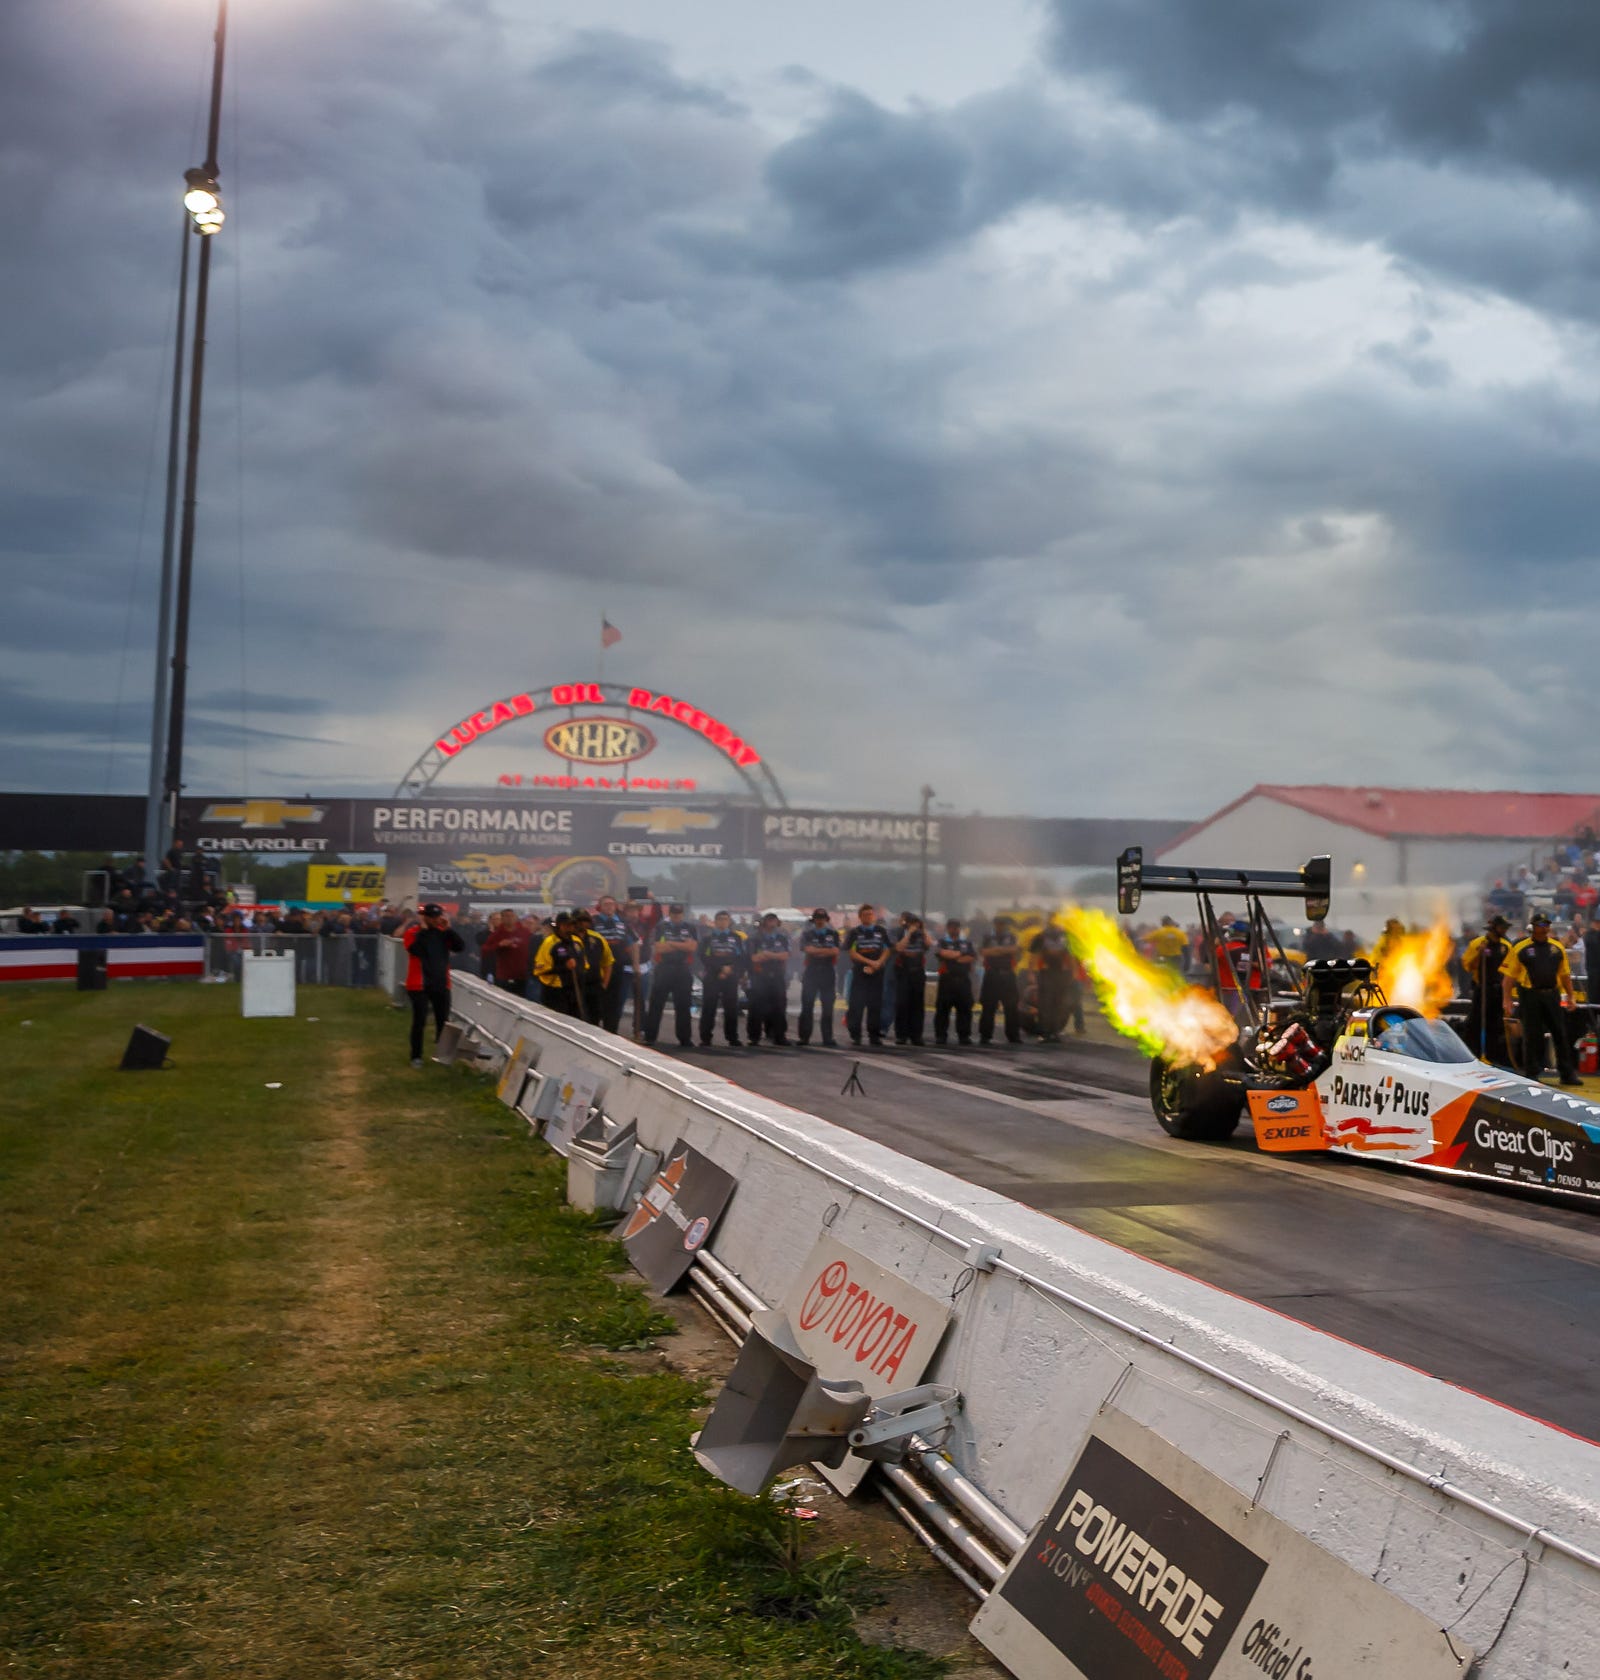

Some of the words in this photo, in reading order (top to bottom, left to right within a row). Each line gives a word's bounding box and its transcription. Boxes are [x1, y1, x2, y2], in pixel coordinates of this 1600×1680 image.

[435, 693, 535, 757] LUCAS
[551, 682, 605, 705] OIL
[628, 687, 762, 767] RACEWAY
[557, 727, 642, 759] NHRA
[533, 775, 696, 791] INDIANAPOLIS
[373, 807, 573, 831] PERFORMANCE
[763, 815, 942, 842] PERFORMANCE
[197, 837, 329, 851] CHEVROLET
[373, 831, 445, 845] VEHICLES
[458, 832, 505, 846] PARTS
[518, 833, 573, 846] RACING
[607, 841, 723, 857] CHEVROLET
[1263, 1126, 1312, 1140] EXIDE
[1474, 1119, 1527, 1155] Great
[1527, 1127, 1574, 1168] Clips
[1557, 1174, 1582, 1187] DENSO
[825, 1281, 918, 1385] TOYOTA
[1055, 1488, 1225, 1658] POWERADE
[1241, 1618, 1303, 1680] Official
